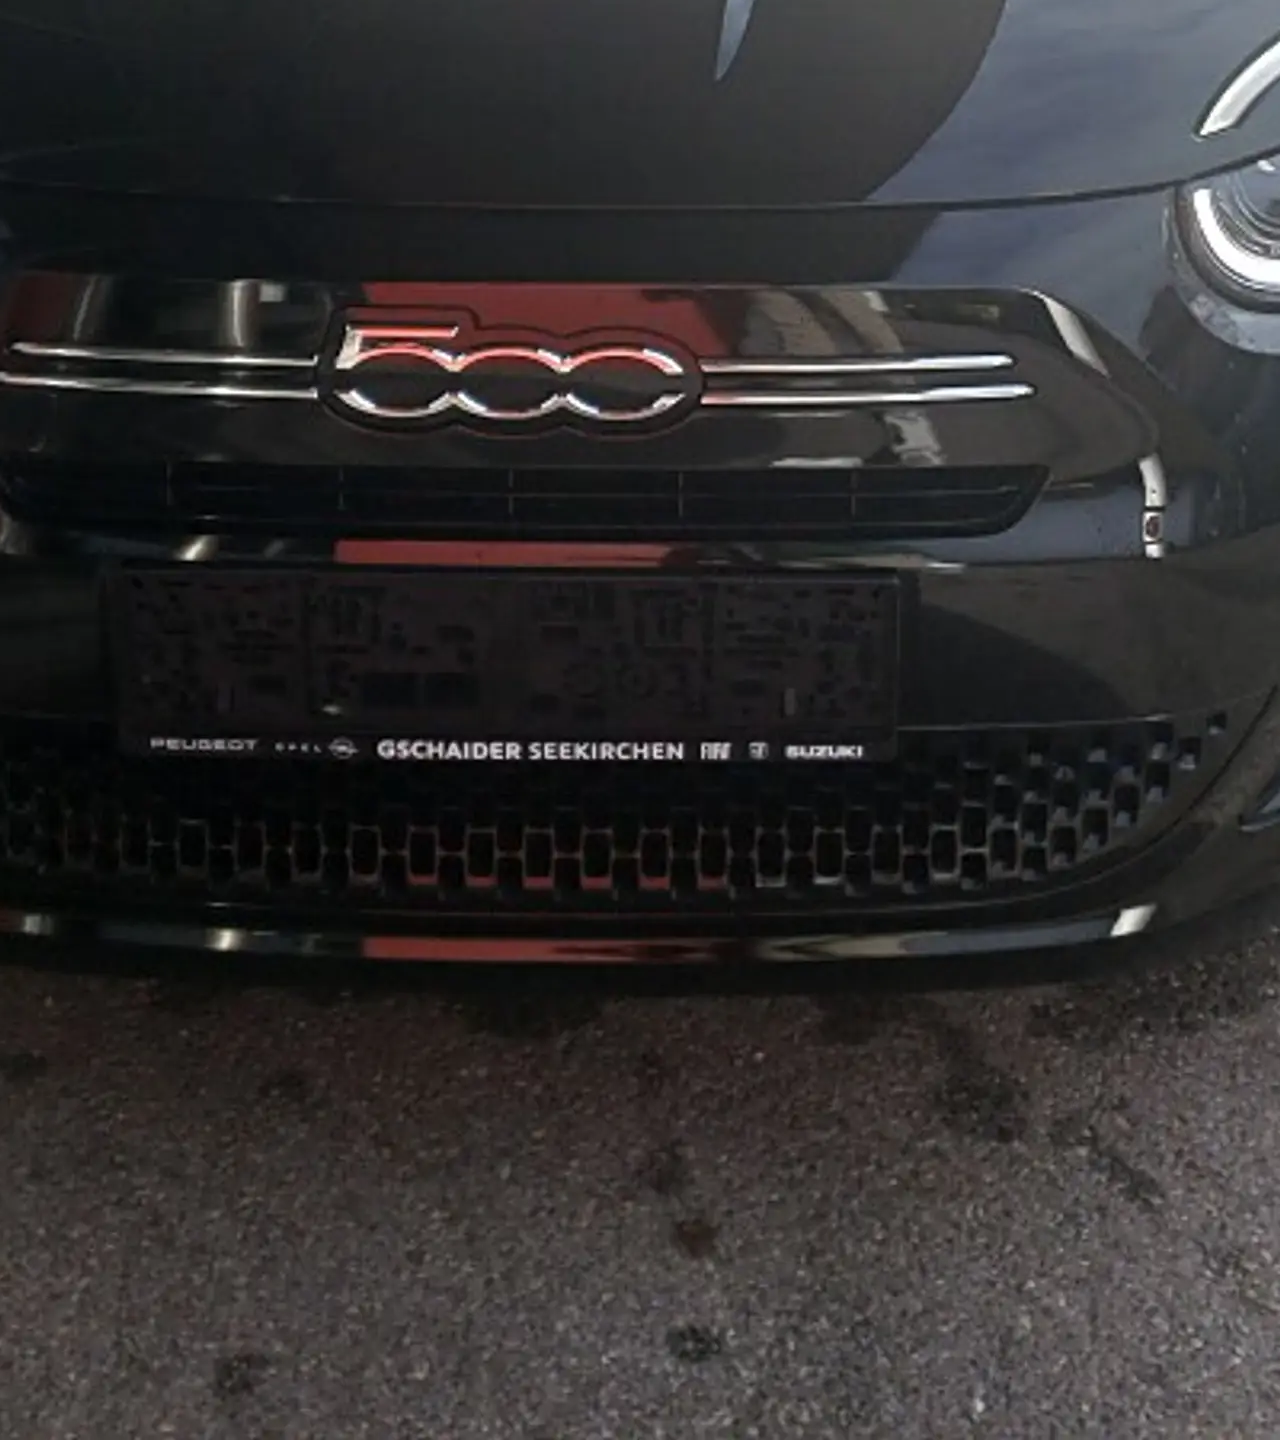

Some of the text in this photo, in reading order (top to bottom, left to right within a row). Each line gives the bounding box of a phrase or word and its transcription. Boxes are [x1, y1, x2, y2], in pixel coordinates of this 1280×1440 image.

[334, 324, 686, 420] 500
[149, 737, 260, 752] PEUGEOT
[376, 737, 521, 760] GSCHAIDER
[527, 740, 685, 760] SEEKIRCHEN
[784, 743, 864, 759] SUZUKI
